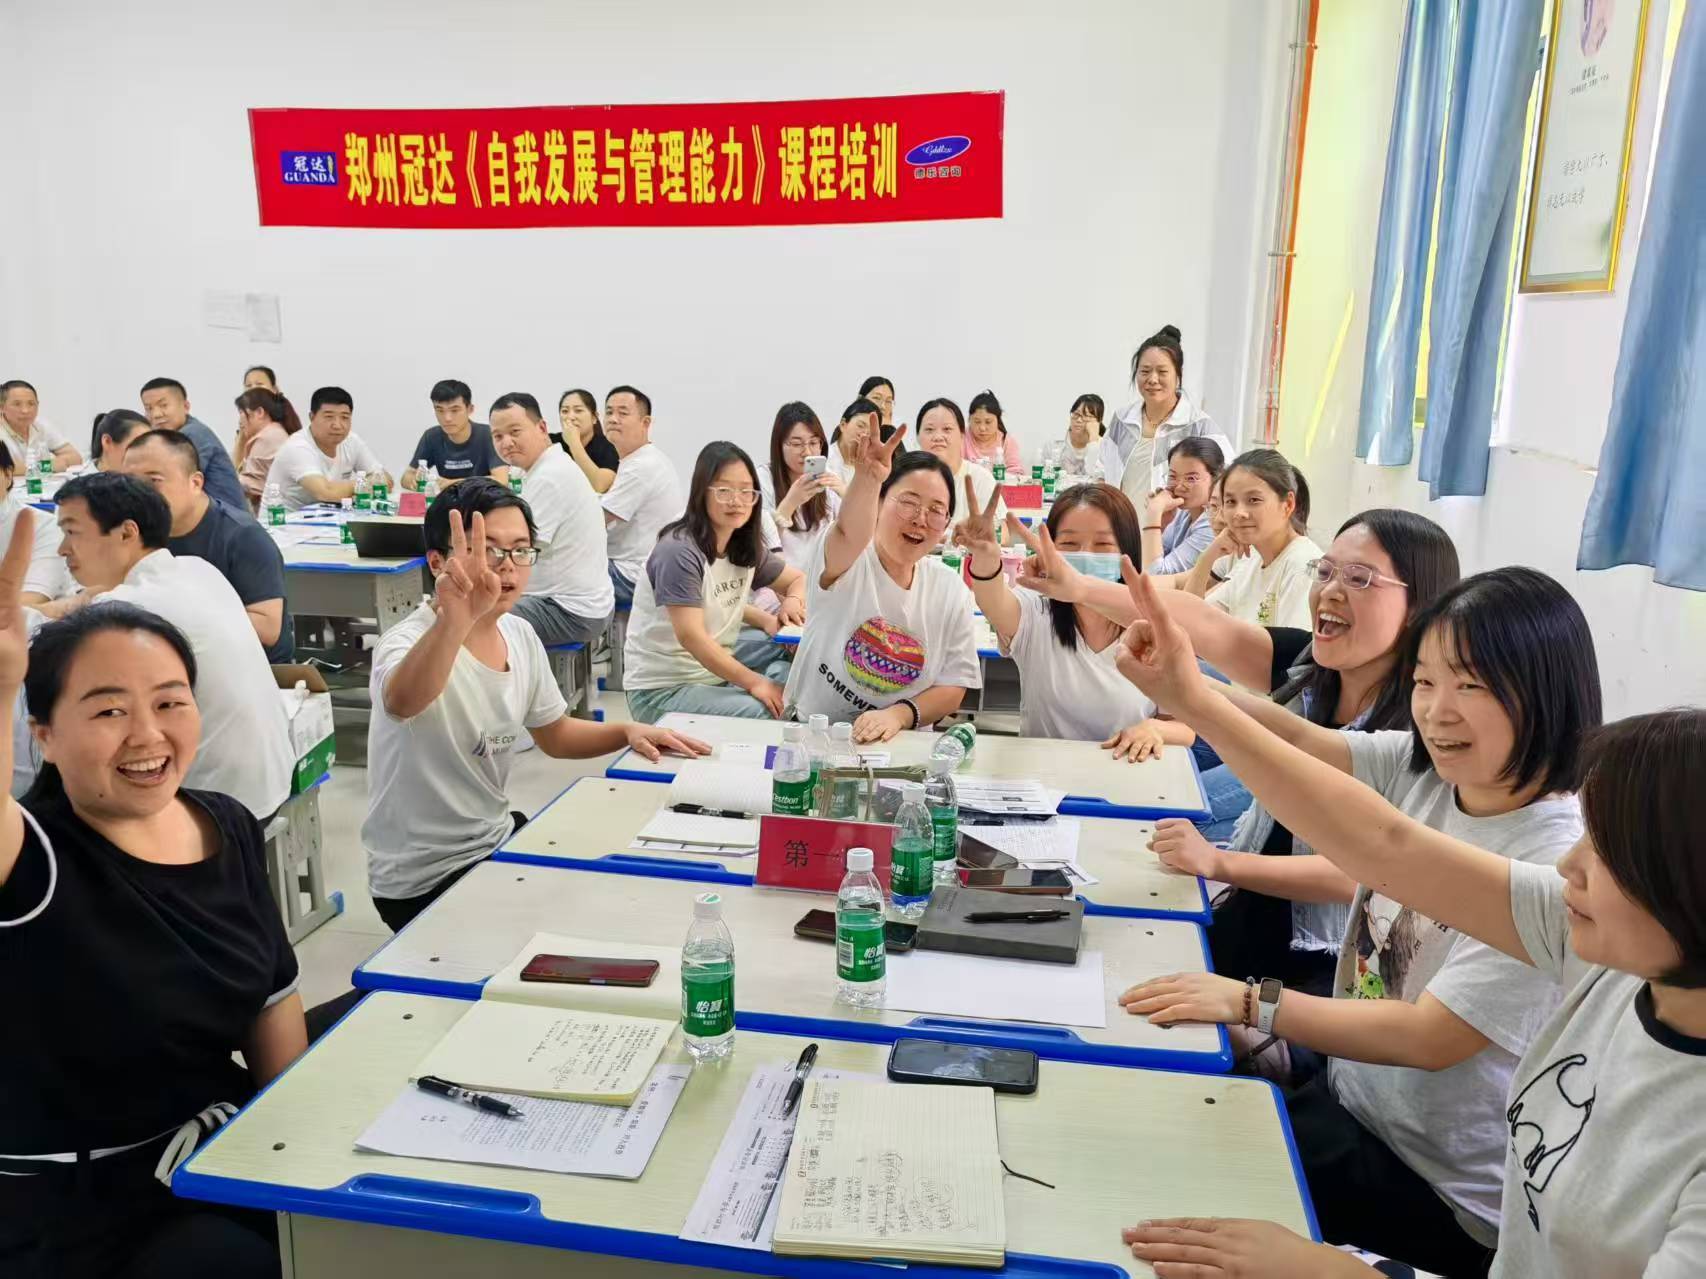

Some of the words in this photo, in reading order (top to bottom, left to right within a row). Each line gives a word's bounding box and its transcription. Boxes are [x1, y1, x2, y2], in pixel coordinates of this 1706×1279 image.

[294, 155, 327, 171] 冠达
[344, 122, 898, 208] 郑州冠达《自我发展与管理能力》课程培训
[284, 172, 335, 183] GUANDA
[784, 839, 842, 870] 第一
